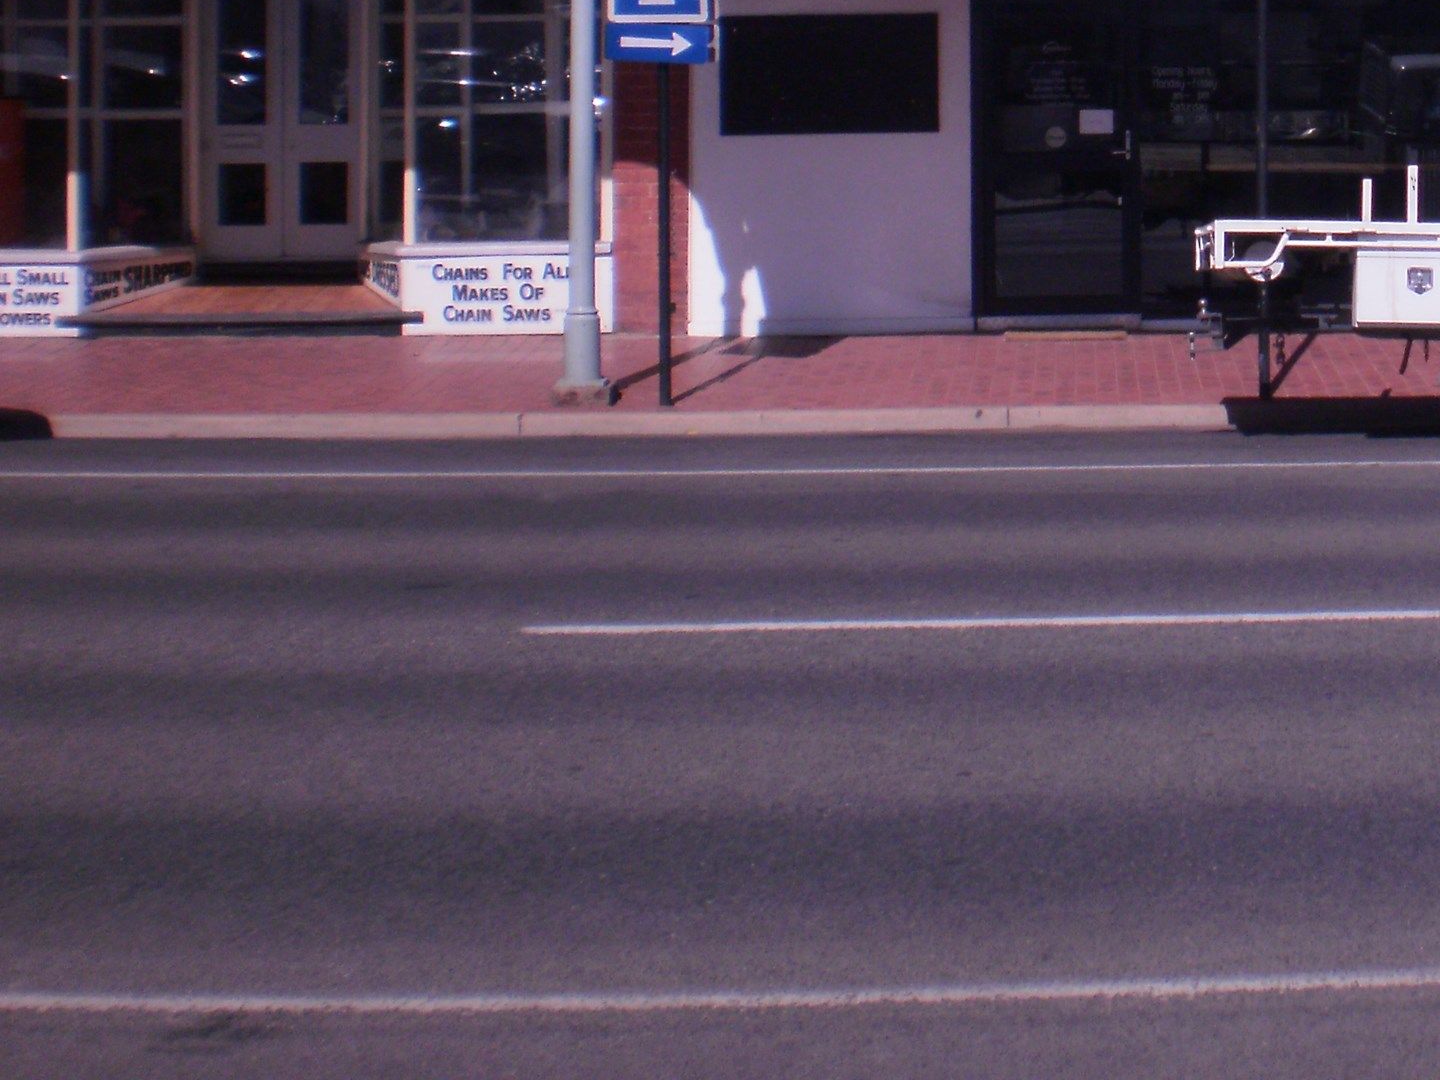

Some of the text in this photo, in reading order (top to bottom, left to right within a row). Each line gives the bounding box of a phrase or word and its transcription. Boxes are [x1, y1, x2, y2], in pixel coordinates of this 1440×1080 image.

[16, 269, 69, 286] SMALL
[431, 263, 489, 281] CHAINS
[502, 263, 533, 281] FOR
[12, 288, 60, 306] SAWS
[452, 283, 545, 301] MAKES OF
[443, 304, 551, 322] CHAIN SAWS
